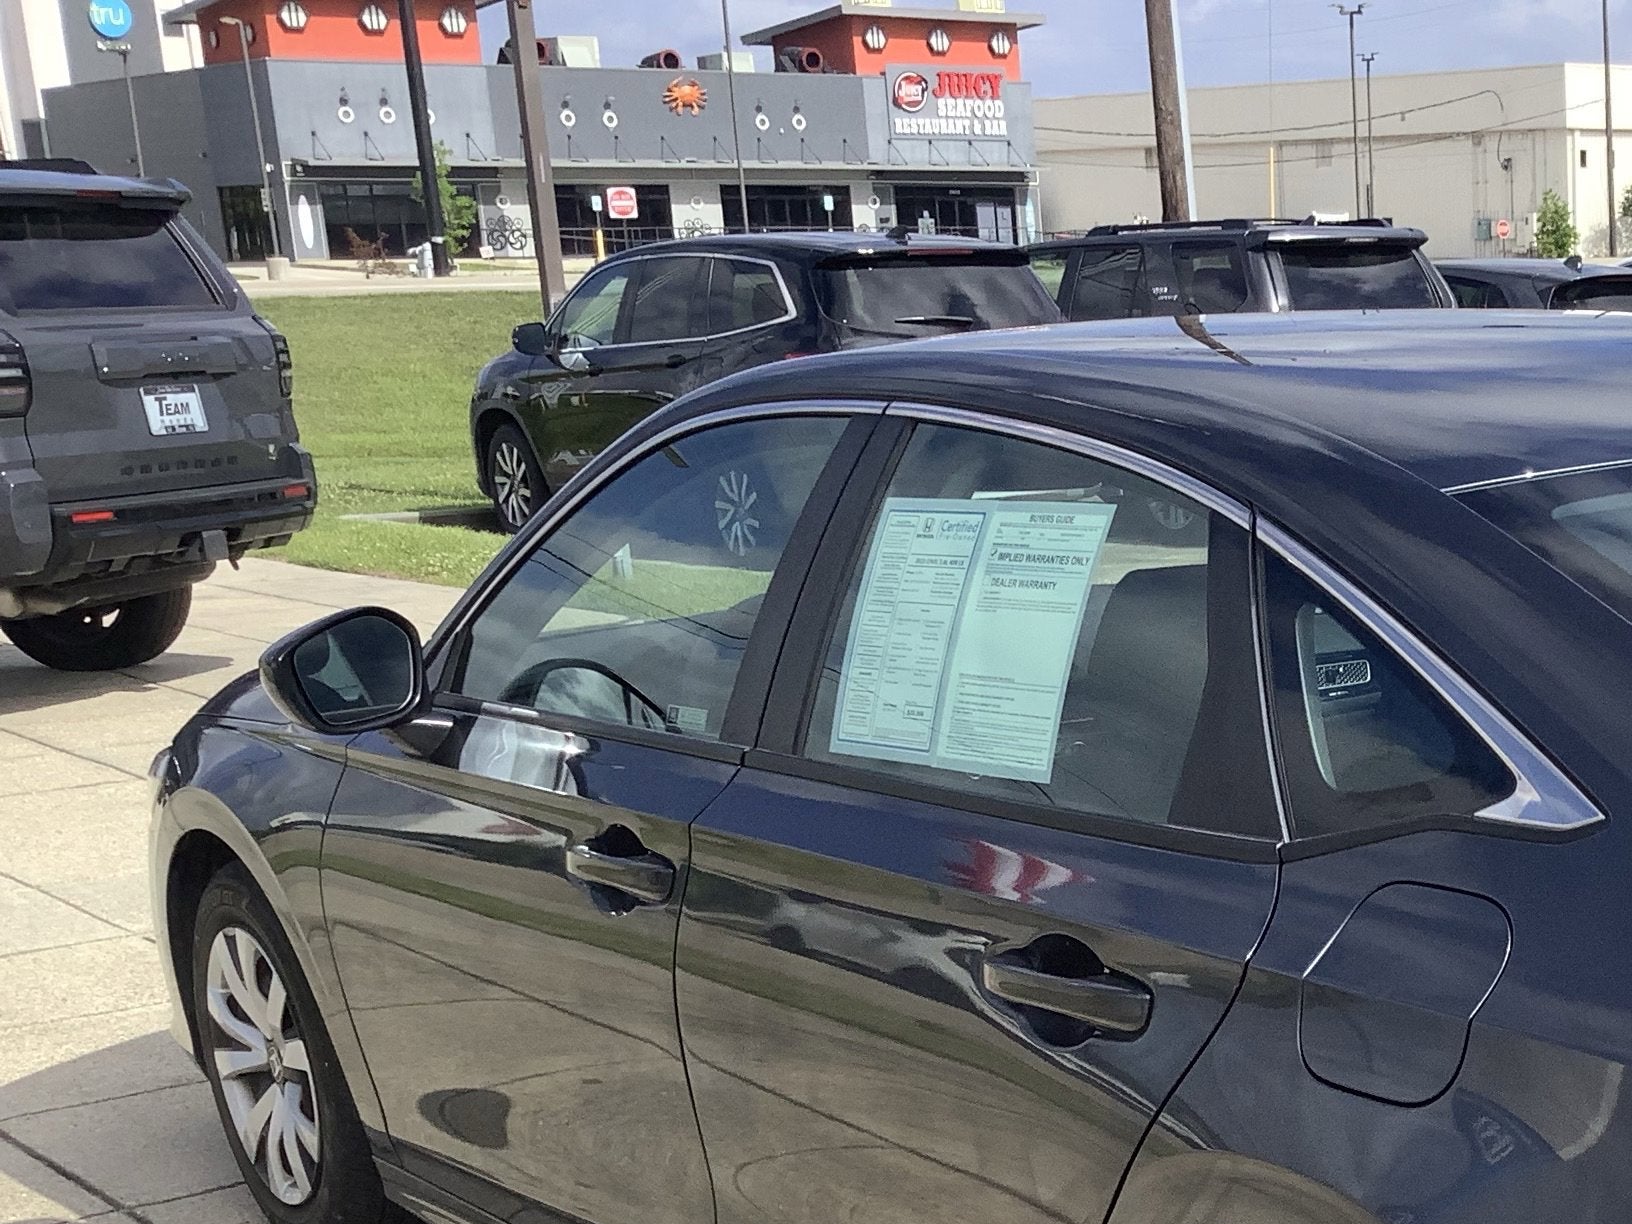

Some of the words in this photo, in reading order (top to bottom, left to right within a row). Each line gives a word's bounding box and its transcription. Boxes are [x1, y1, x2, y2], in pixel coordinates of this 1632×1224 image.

[90, 0, 124, 25] tru
[932, 72, 1002, 99] JUICY
[936, 98, 1005, 118] SEAFOOD
[894, 117, 970, 135] RESTAURANT
[973, 119, 982, 136] &
[984, 120, 1008, 136] BAR
[154, 396, 190, 416] TEAM
[941, 519, 980, 533] Certified
[1029, 514, 1055, 523] BUYERS
[1056, 515, 1075, 524] GUIDE
[998, 552, 1025, 562] IMPLIED
[1025, 553, 1070, 565] WARRANTIES
[1071, 556, 1090, 566] ONLY
[991, 578, 1018, 588] DEALER
[1018, 578, 1057, 590] WARRANTY
